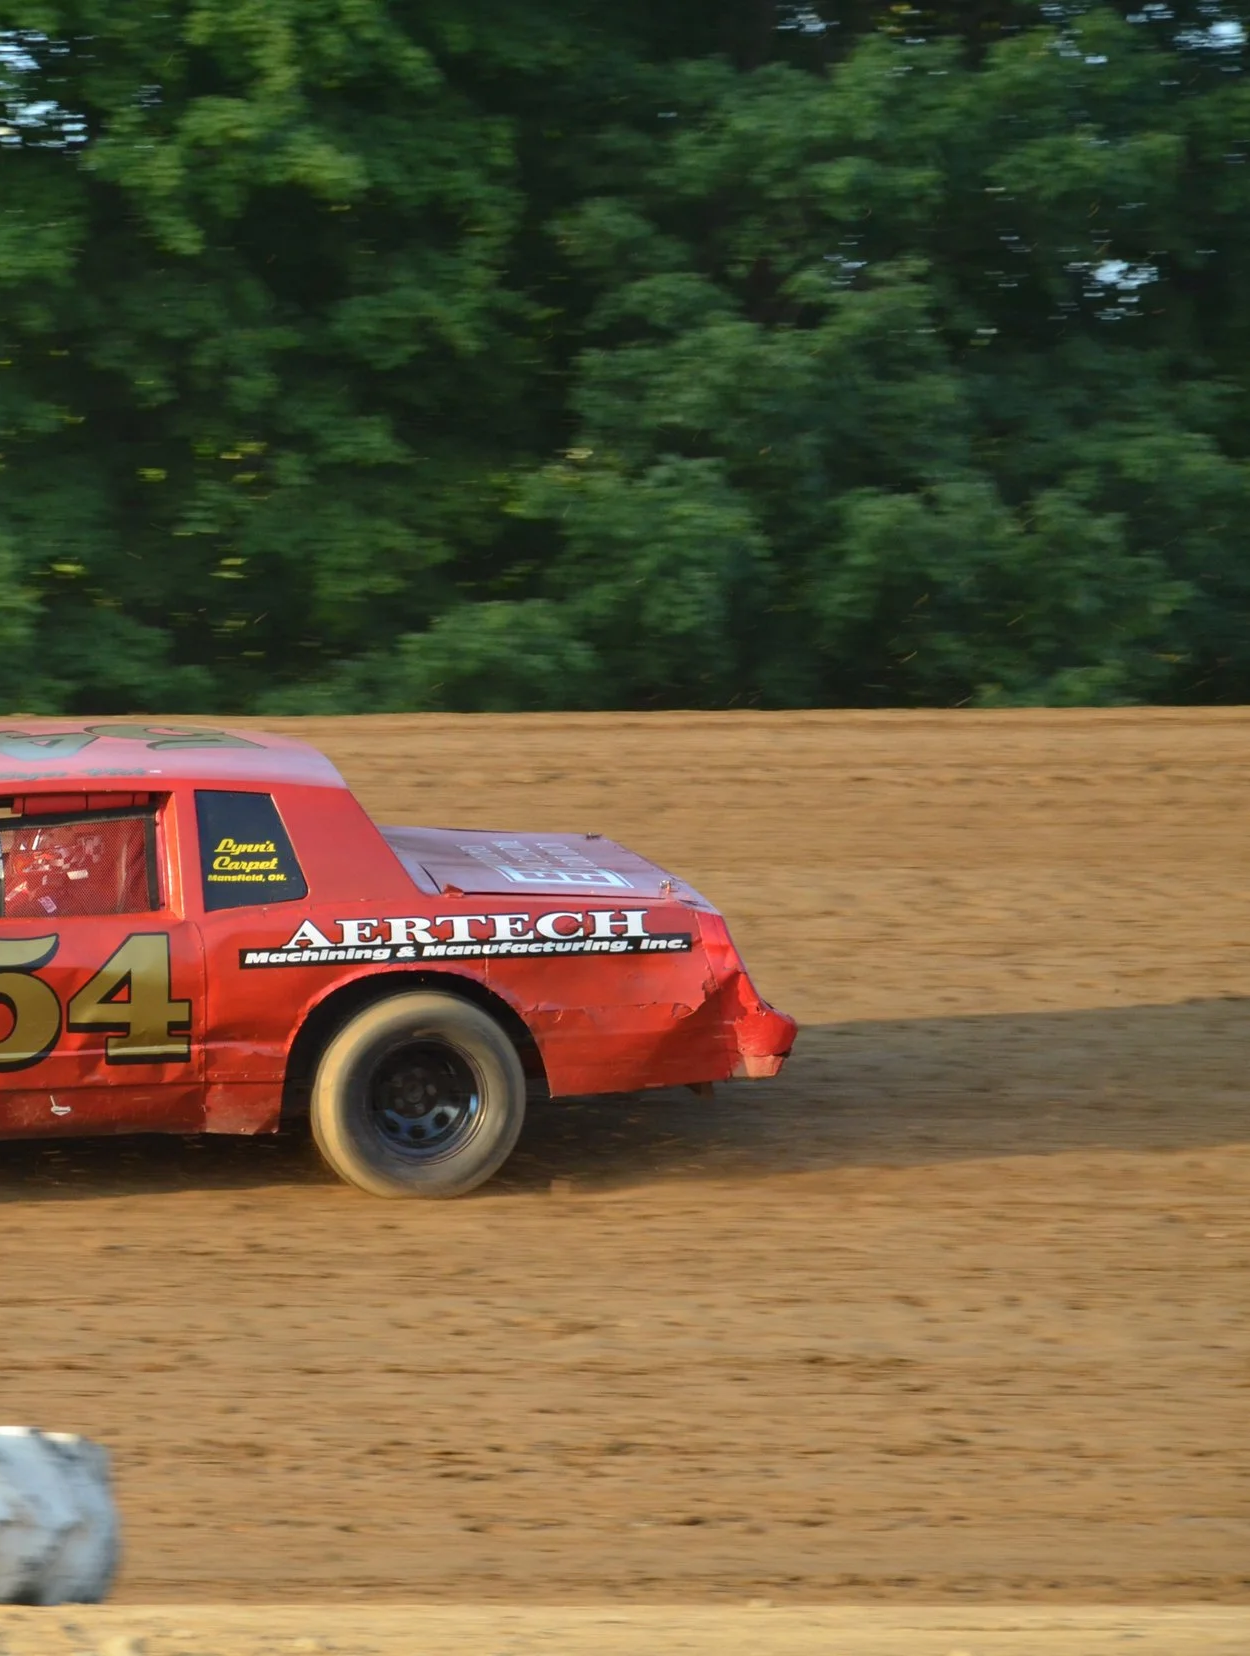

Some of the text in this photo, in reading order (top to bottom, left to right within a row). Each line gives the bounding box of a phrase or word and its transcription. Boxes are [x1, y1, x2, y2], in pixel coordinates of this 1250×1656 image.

[213, 837, 276, 856] Lynn's
[212, 855, 279, 873] Carpet
[281, 909, 649, 949] AERTECH
[244, 948, 391, 965] Machining
[396, 945, 417, 958] &
[640, 938, 688, 950] Inc.
